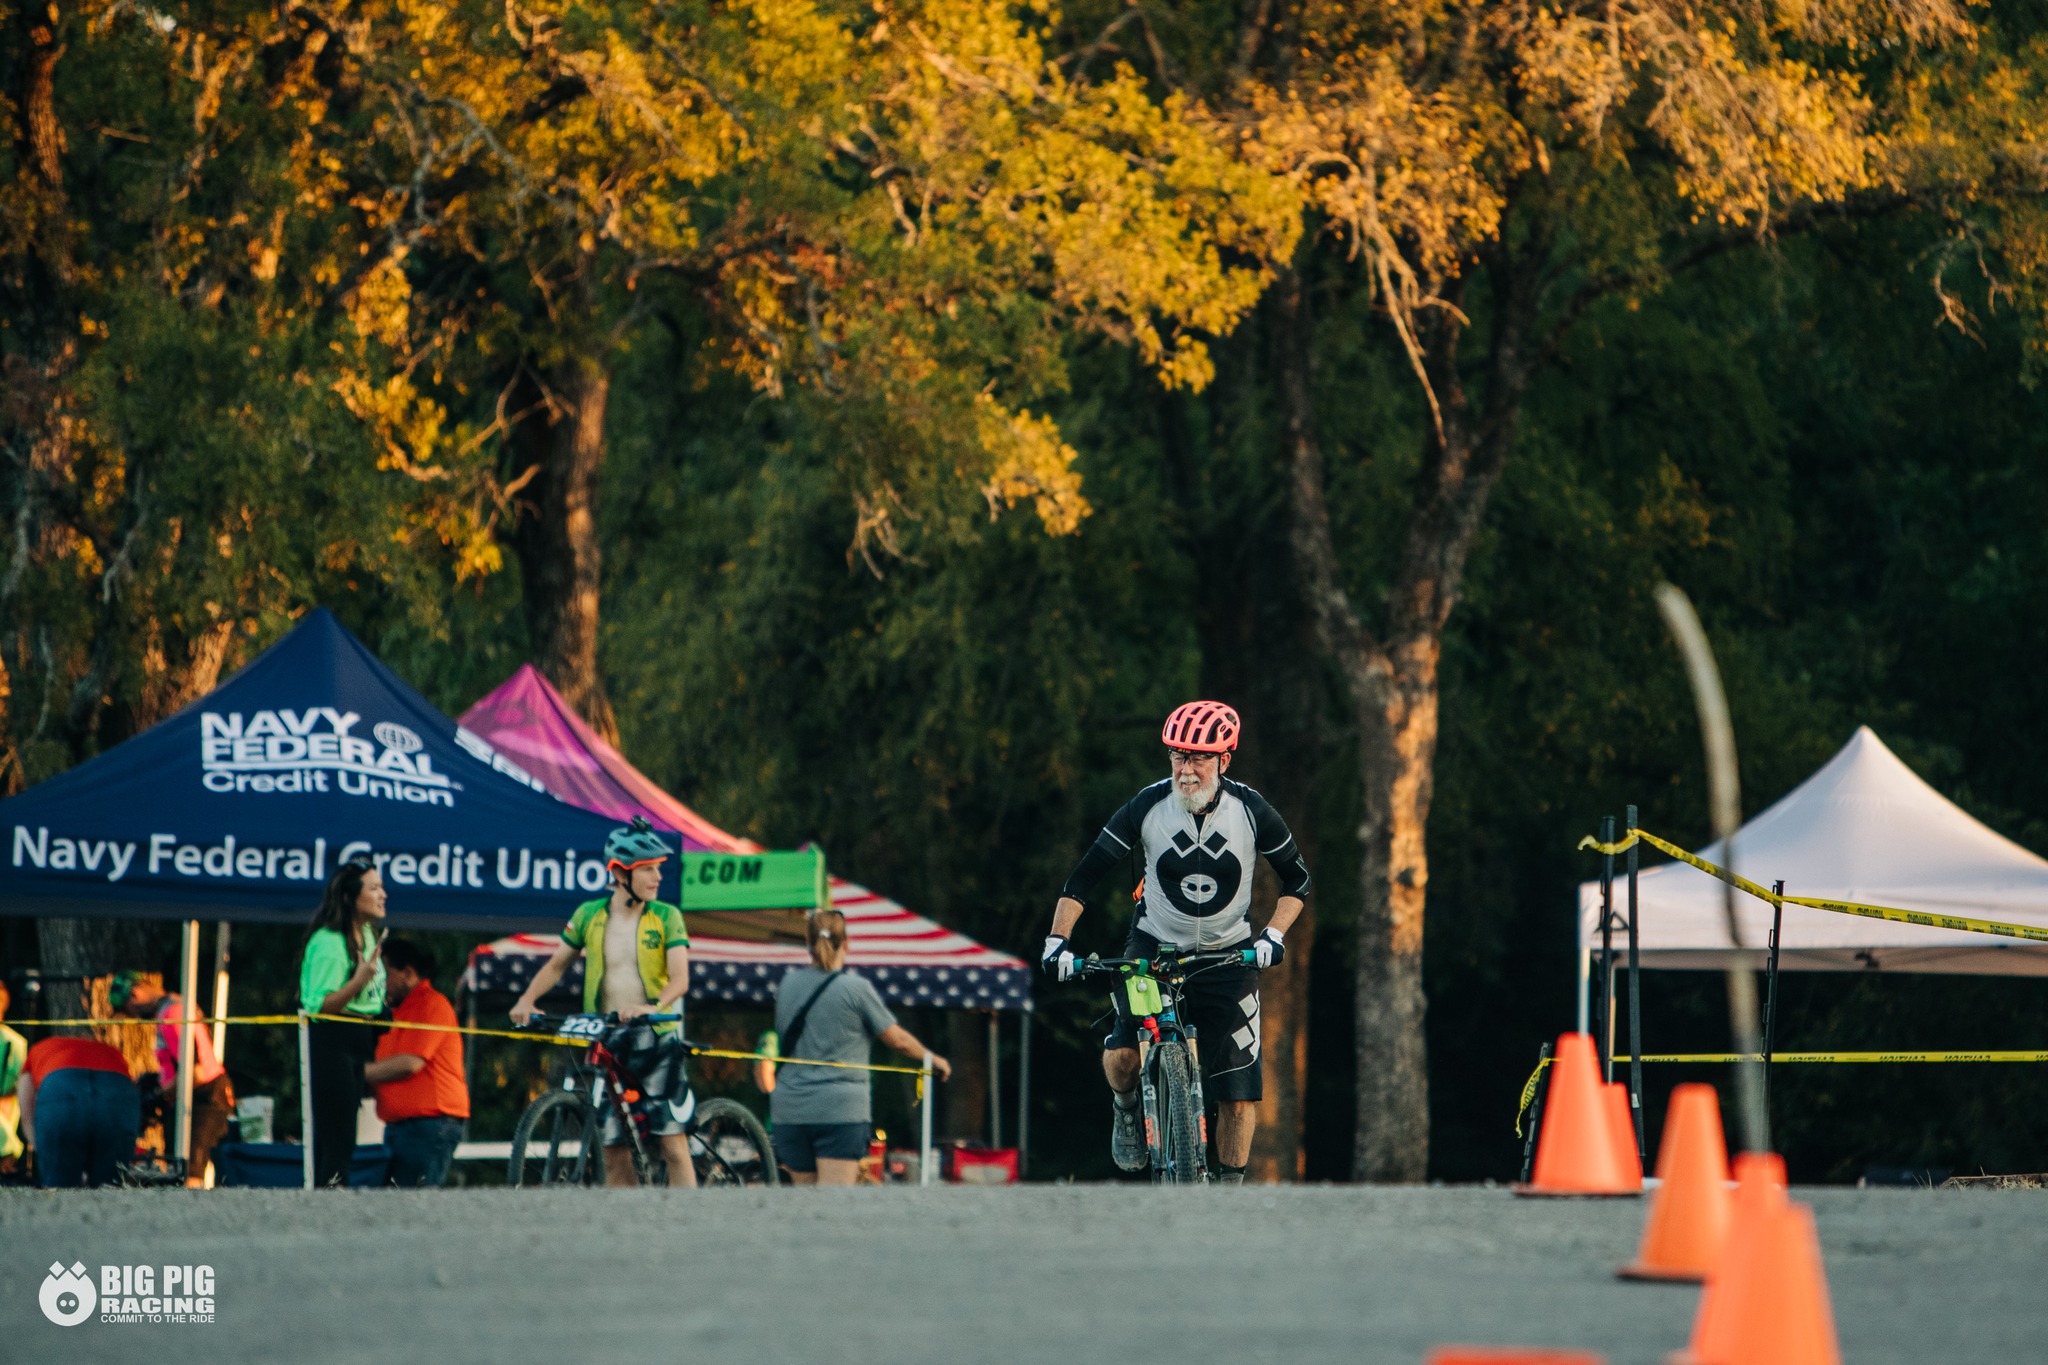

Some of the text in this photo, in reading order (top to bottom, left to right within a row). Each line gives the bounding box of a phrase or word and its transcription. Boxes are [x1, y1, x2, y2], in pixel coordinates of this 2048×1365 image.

[201, 707, 361, 738] NAVY
[202, 732, 449, 786] FEDERAL
[202, 770, 454, 807] Credit Union
[12, 825, 136, 882] Navy
[149, 833, 326, 880] Federal
[496, 847, 615, 892] Unio
[682, 860, 762, 885] .COM
[559, 1016, 604, 1035] 220
